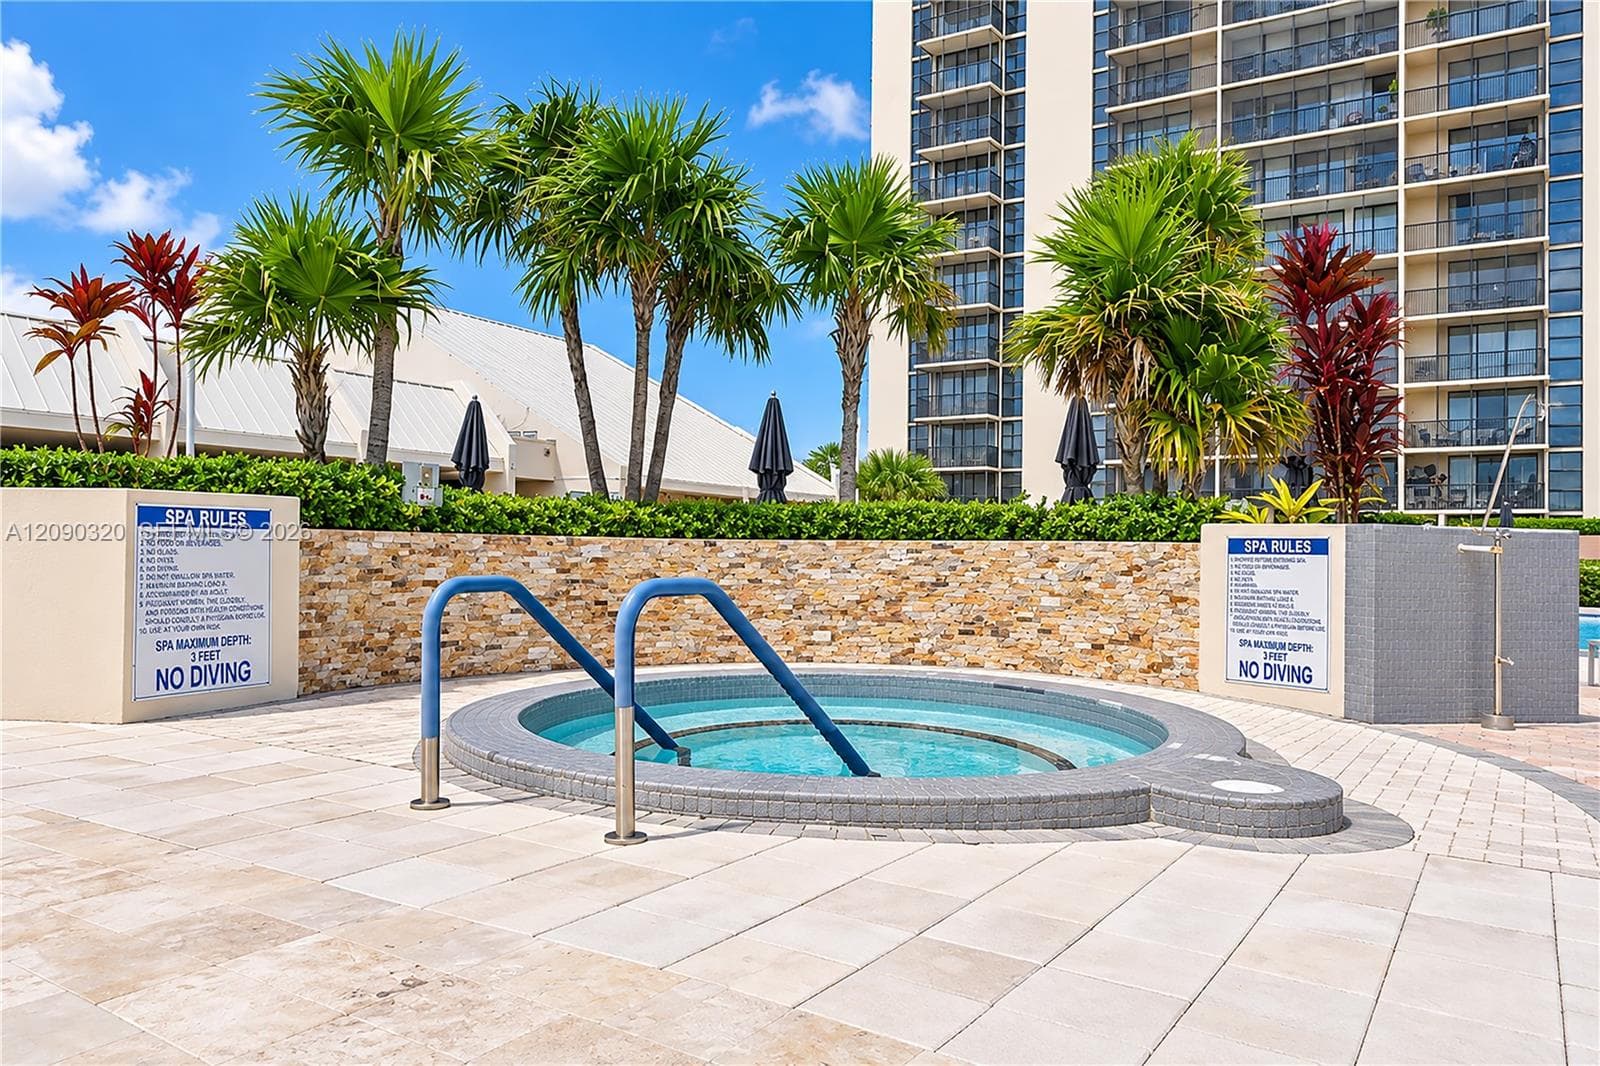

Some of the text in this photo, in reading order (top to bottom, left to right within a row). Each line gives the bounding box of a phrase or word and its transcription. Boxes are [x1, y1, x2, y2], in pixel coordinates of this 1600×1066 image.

[165, 509, 247, 526] SPA RULES
[1244, 540, 1312, 553] SPA RULES
[155, 635, 252, 652] SPA MAXIMUM DEPTH:
[1239, 639, 1314, 653] SPA MAXIMUM DEPTH:
[191, 650, 221, 662] 3 FEET
[1269, 652, 1288, 661] FEET
[156, 661, 251, 691] NO DIVING
[1239, 660, 1313, 684] NO DIVING
